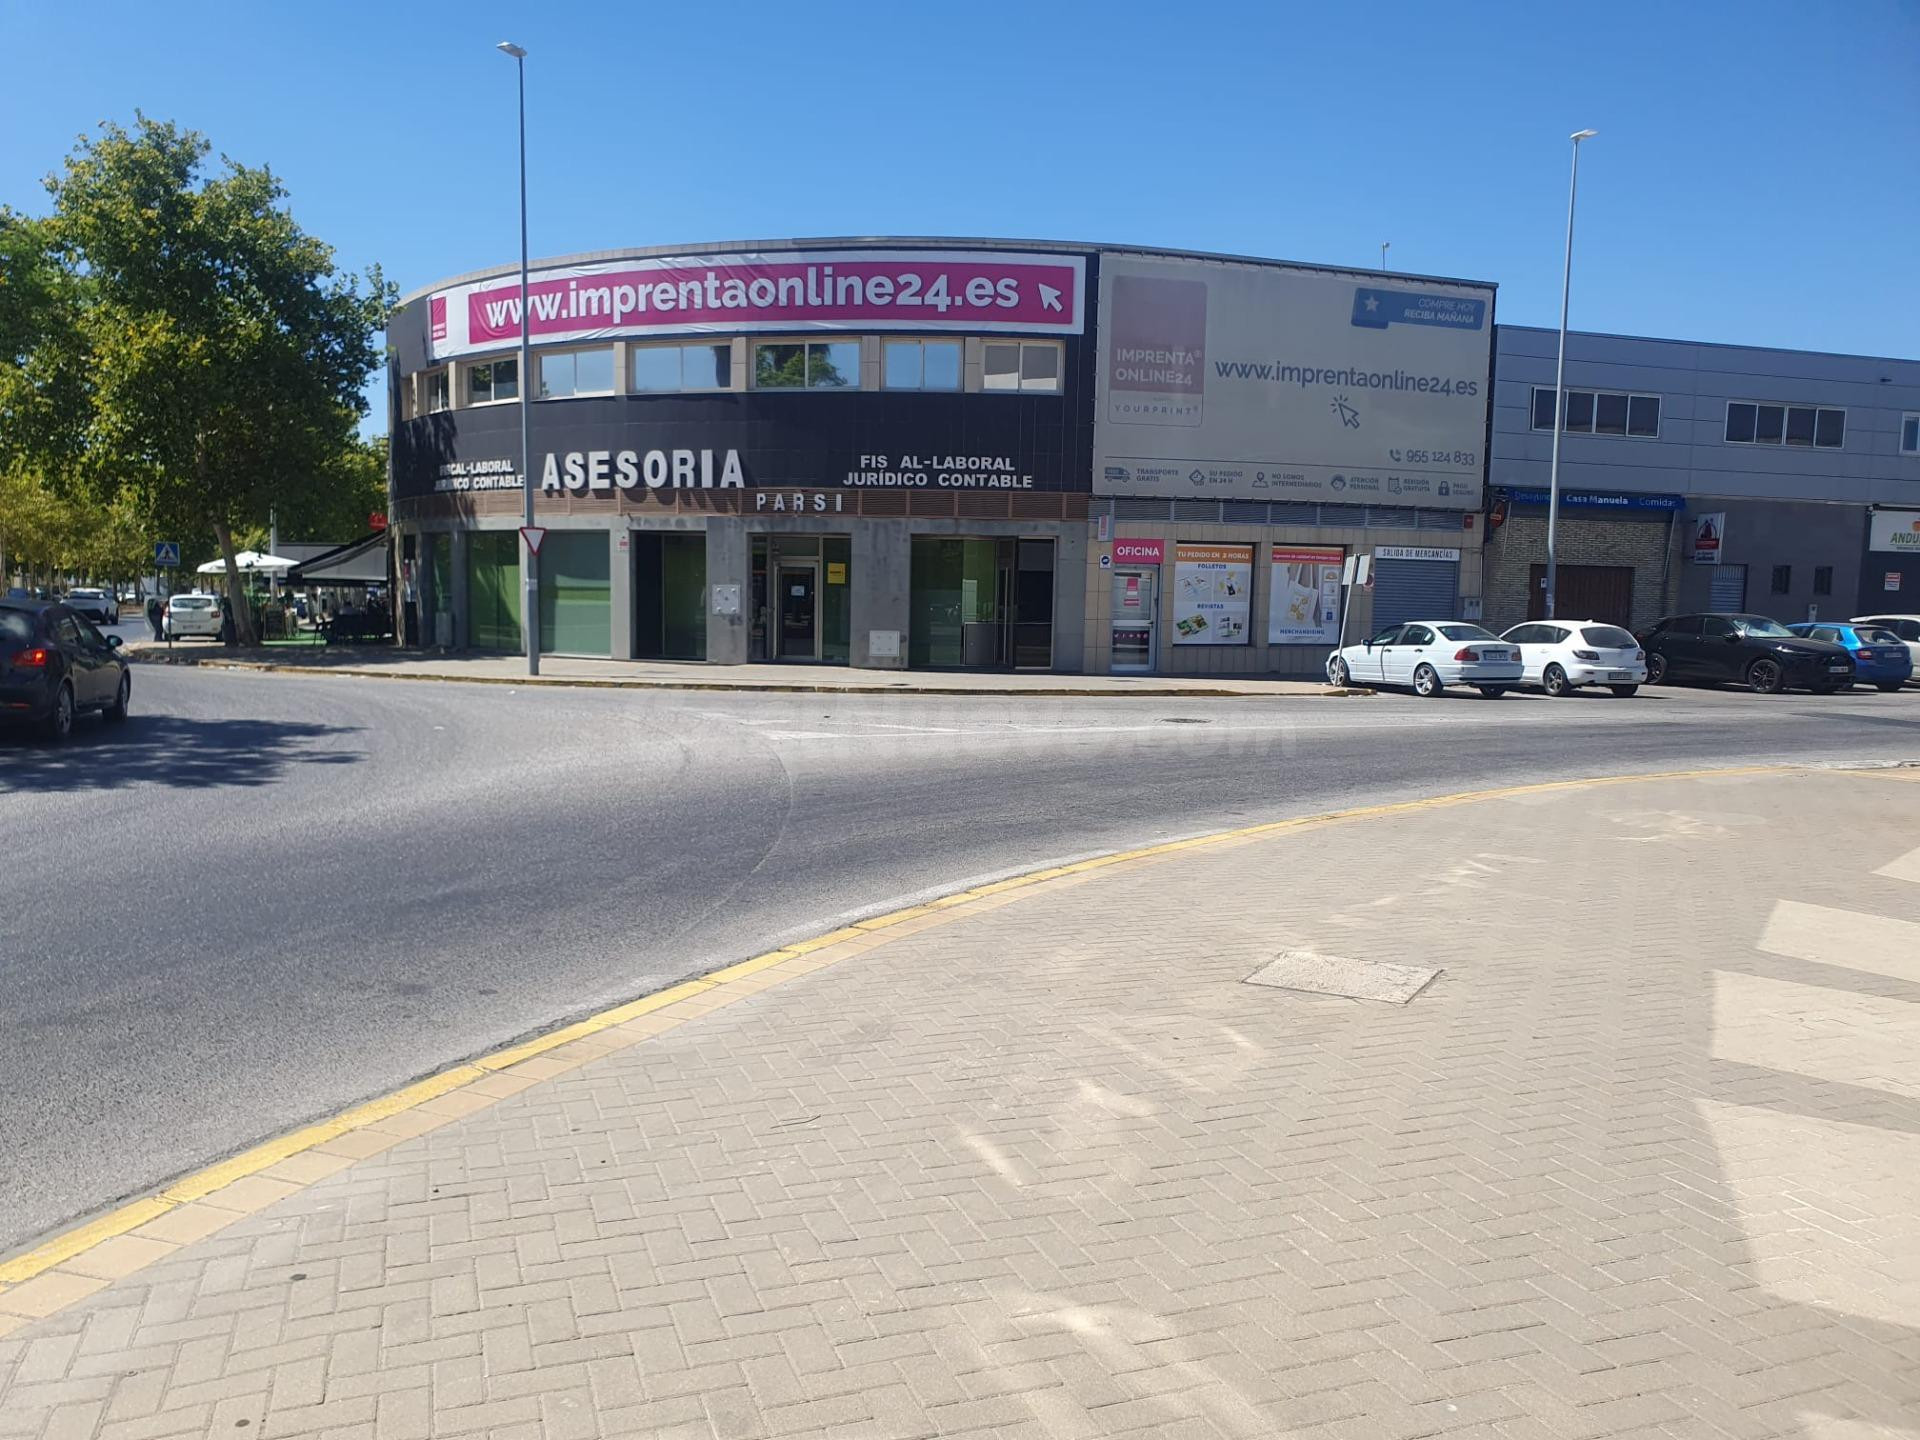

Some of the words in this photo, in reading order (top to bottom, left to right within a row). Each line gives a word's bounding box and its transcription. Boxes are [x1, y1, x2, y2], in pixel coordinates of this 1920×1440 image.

[486, 266, 1018, 328] www.imprentaonline24.es
[1404, 308, 1434, 320] RECIBA
[1115, 367, 1193, 385] ONLINE24
[1215, 360, 1478, 396] www.imprentaonline24.es
[860, 455, 888, 469] FIS
[900, 455, 1015, 471] AL-LABORAL
[1406, 450, 1429, 464] 955
[1432, 451, 1451, 465] 124
[1454, 451, 1475, 466] 833
[541, 449, 745, 490] ASESORIA
[473, 475, 524, 490] CONTABLE
[843, 470, 928, 486] JURÍDICO
[938, 473, 1032, 489] CONTABLE
[756, 493, 842, 512] PARSI
[1566, 494, 1588, 503] Casa
[1590, 495, 1629, 505] Manuela
[1116, 546, 1160, 556] OFICINA
[1383, 548, 1404, 557] SALIDA
[1405, 549, 1413, 557] DE
